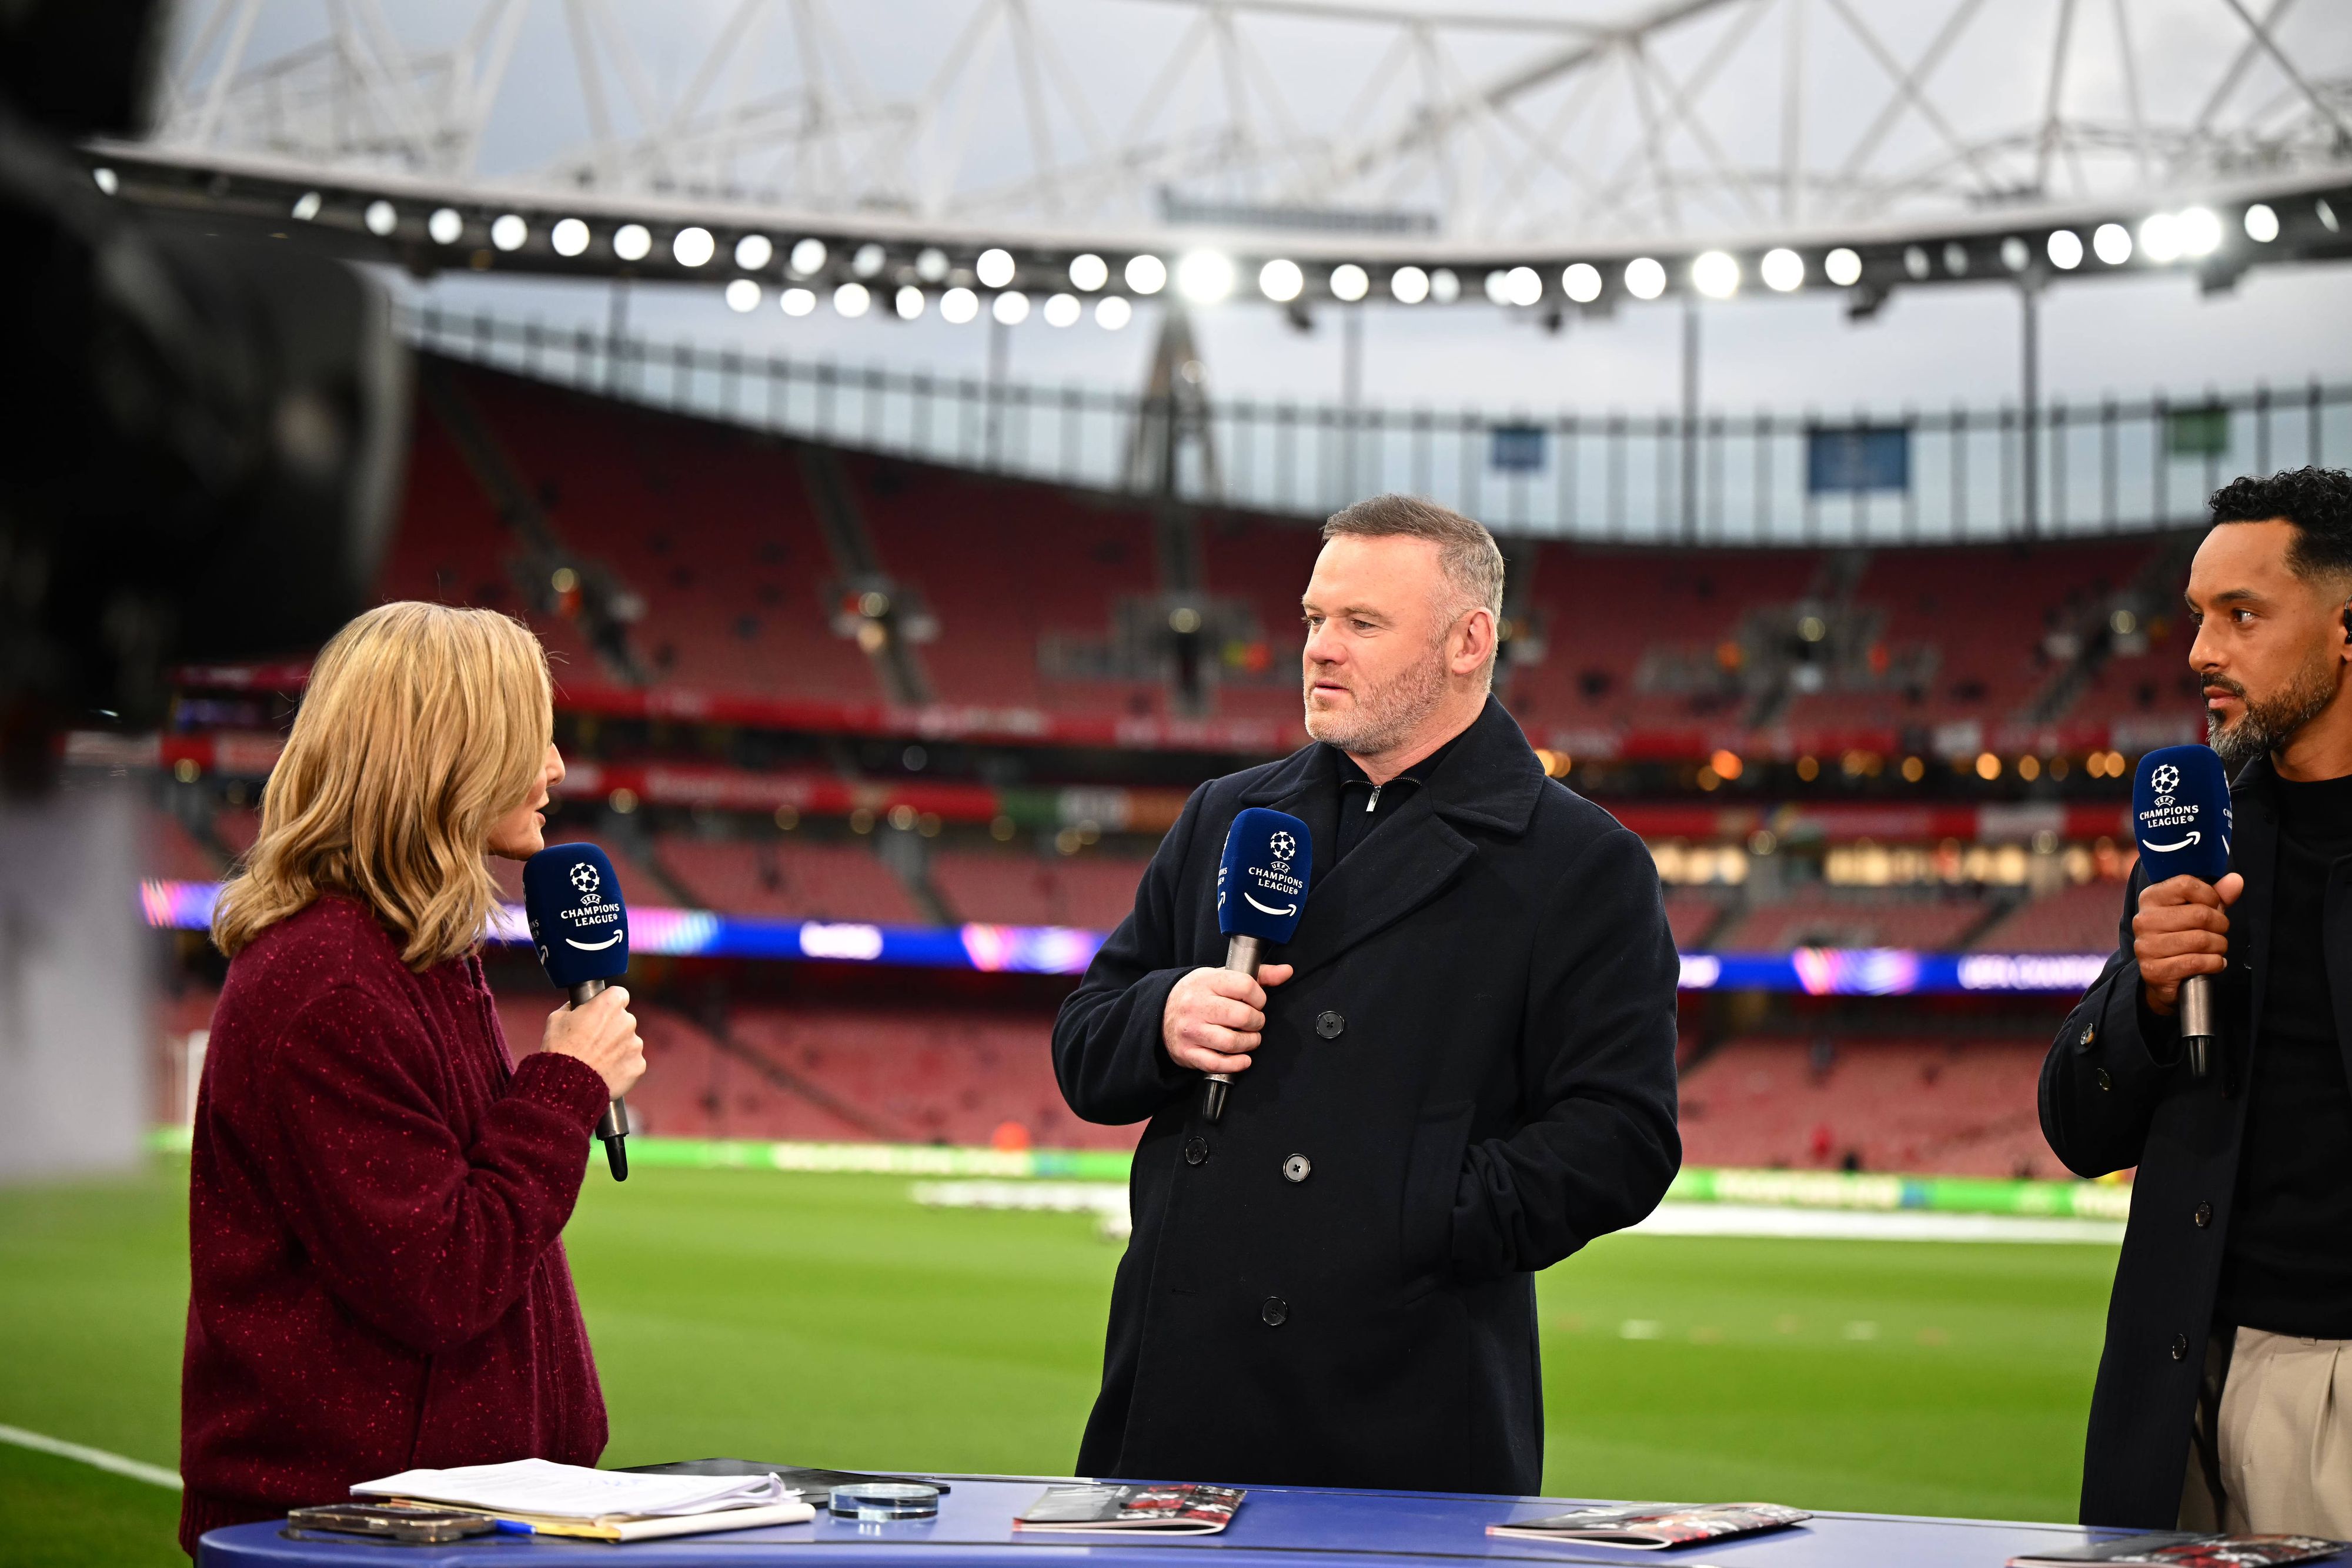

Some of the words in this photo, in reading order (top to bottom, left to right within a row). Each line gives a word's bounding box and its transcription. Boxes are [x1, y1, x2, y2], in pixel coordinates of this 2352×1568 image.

[2156, 797, 2174, 806] UEFA
[2139, 804, 2199, 821] CHAMPIONS
[1271, 862, 1289, 873] UEFA
[1248, 867, 1303, 888] CHAMPIONS
[582, 895, 602, 905] UEFA
[560, 903, 620, 920] CHAMPIONS
